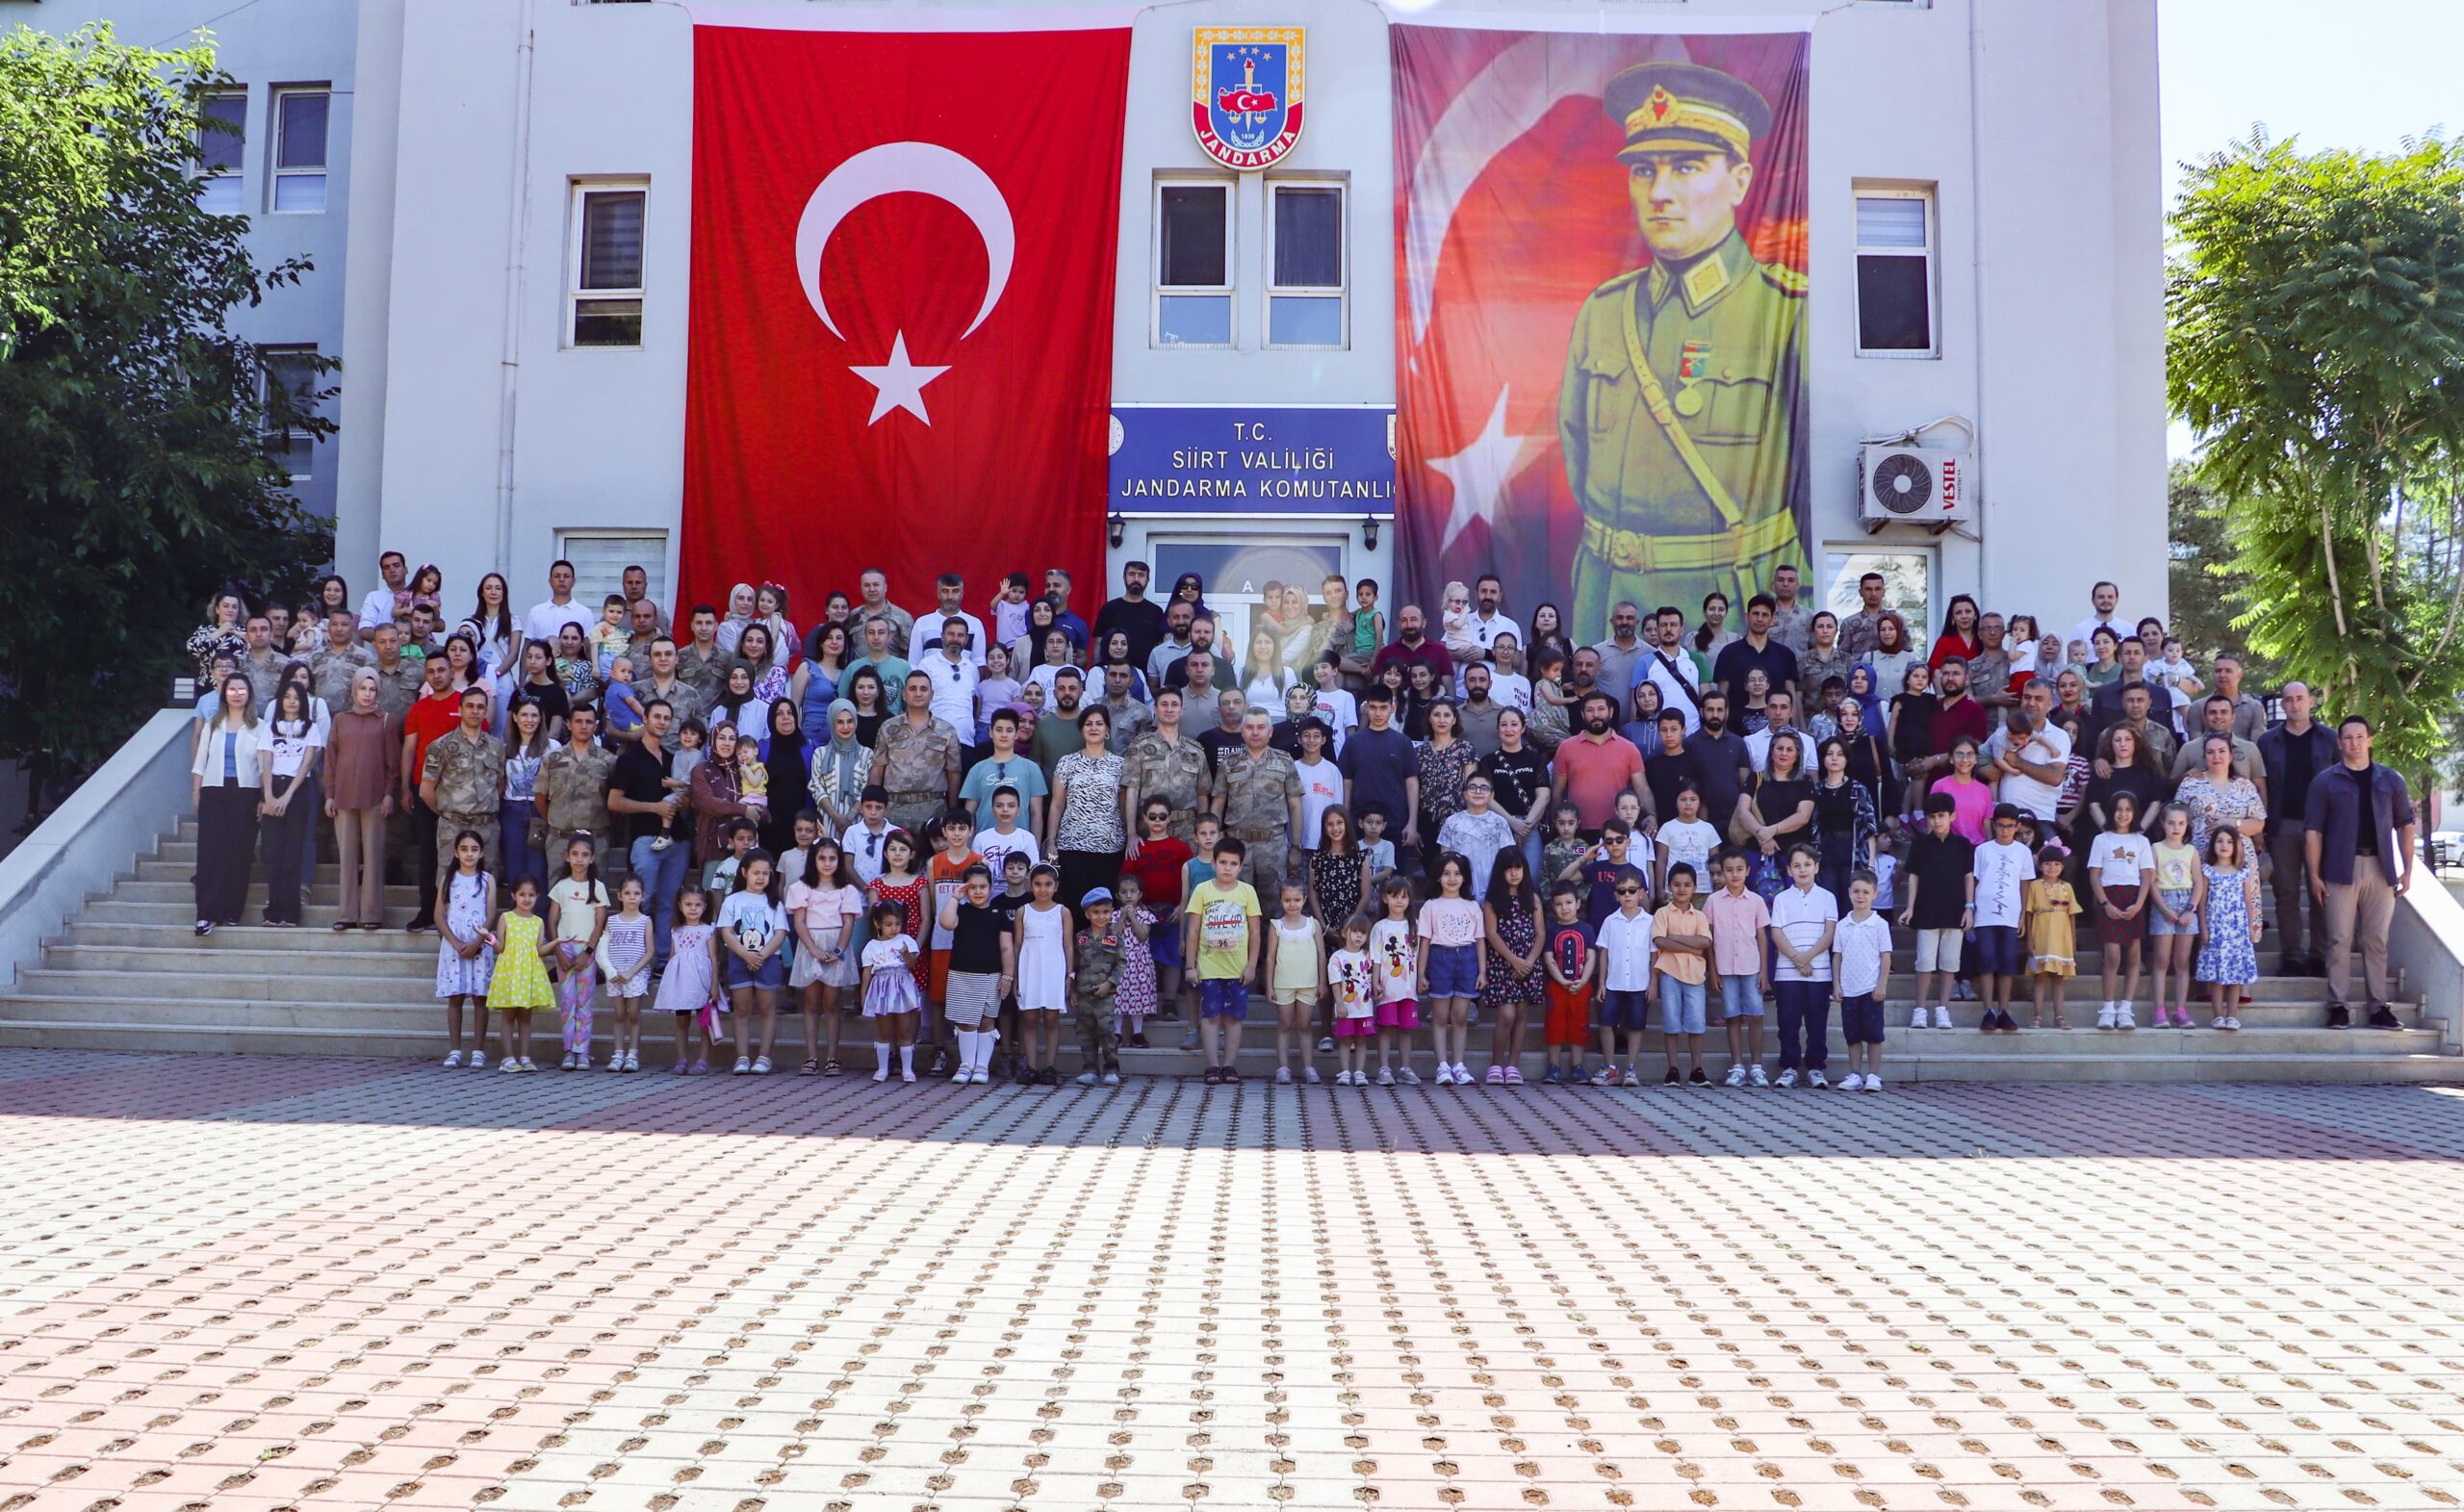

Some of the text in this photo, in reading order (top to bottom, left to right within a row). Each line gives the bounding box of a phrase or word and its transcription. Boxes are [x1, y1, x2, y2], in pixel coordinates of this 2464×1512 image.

[1200, 130, 1296, 166] JANDARMA
[1234, 423, 1272, 442] T.C.
[1172, 447, 1335, 470] SİİRT VALİLİĞİ
[1121, 479, 1396, 499] JANDARMA KOMUTANLI
[1942, 458, 1956, 510] VESTEL
[1242, 579, 1254, 593] A
[1597, 871, 1616, 883] US
[1208, 913, 1243, 930] GIVE UP
[1218, 938, 1228, 948] 96
